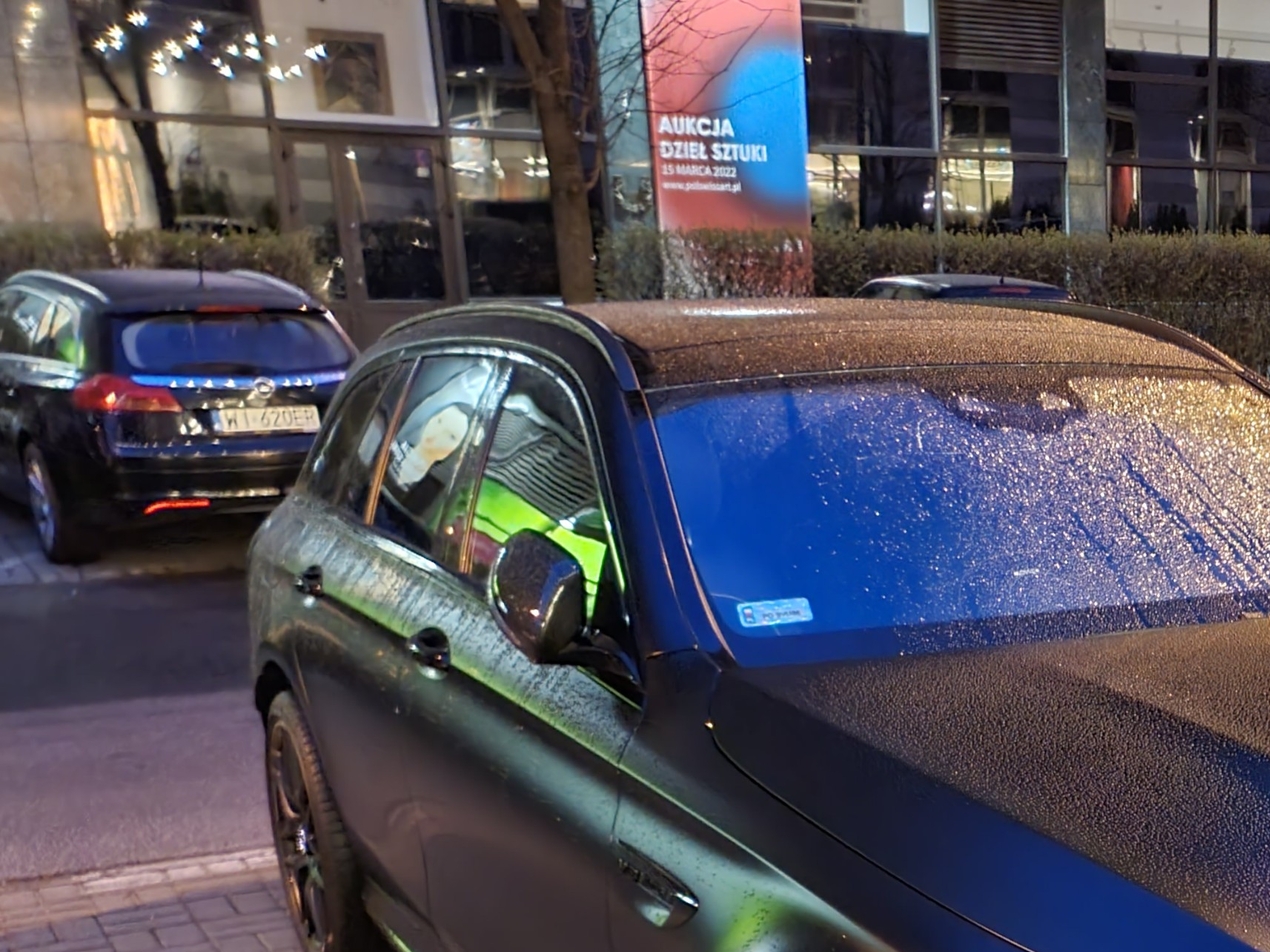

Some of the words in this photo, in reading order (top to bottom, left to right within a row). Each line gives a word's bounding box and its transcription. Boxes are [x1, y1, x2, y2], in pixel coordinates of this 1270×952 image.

[659, 116, 734, 137] AUKCJA
[660, 141, 708, 160] DZIEŁ
[712, 143, 768, 162] SZTUKI
[662, 164, 674, 176] 15
[676, 165, 712, 177] MARCA
[714, 166, 737, 178] 2022
[261, 408, 315, 427] 620ER
